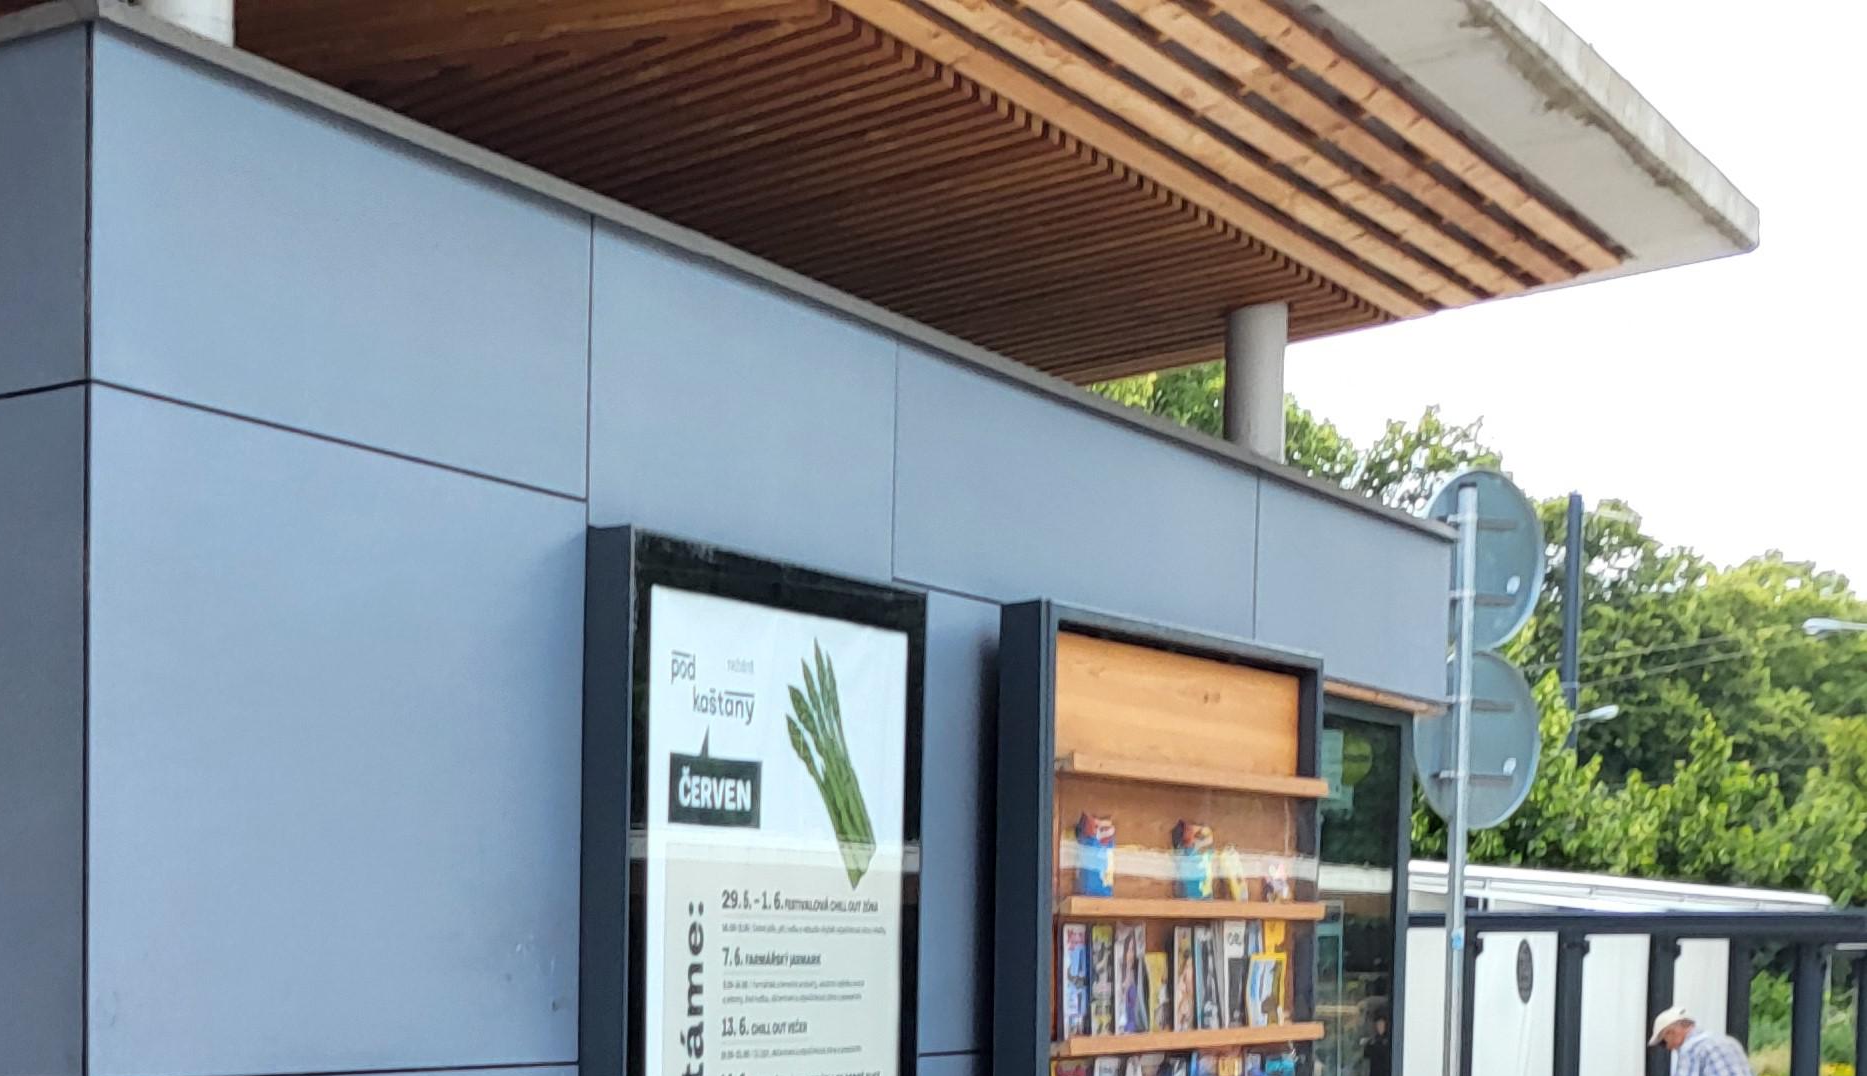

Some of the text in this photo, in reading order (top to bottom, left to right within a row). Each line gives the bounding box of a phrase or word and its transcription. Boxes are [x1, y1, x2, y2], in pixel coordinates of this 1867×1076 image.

[671, 651, 696, 684] pod
[693, 686, 755, 725] kaštany
[678, 765, 752, 812] ČERVEN
